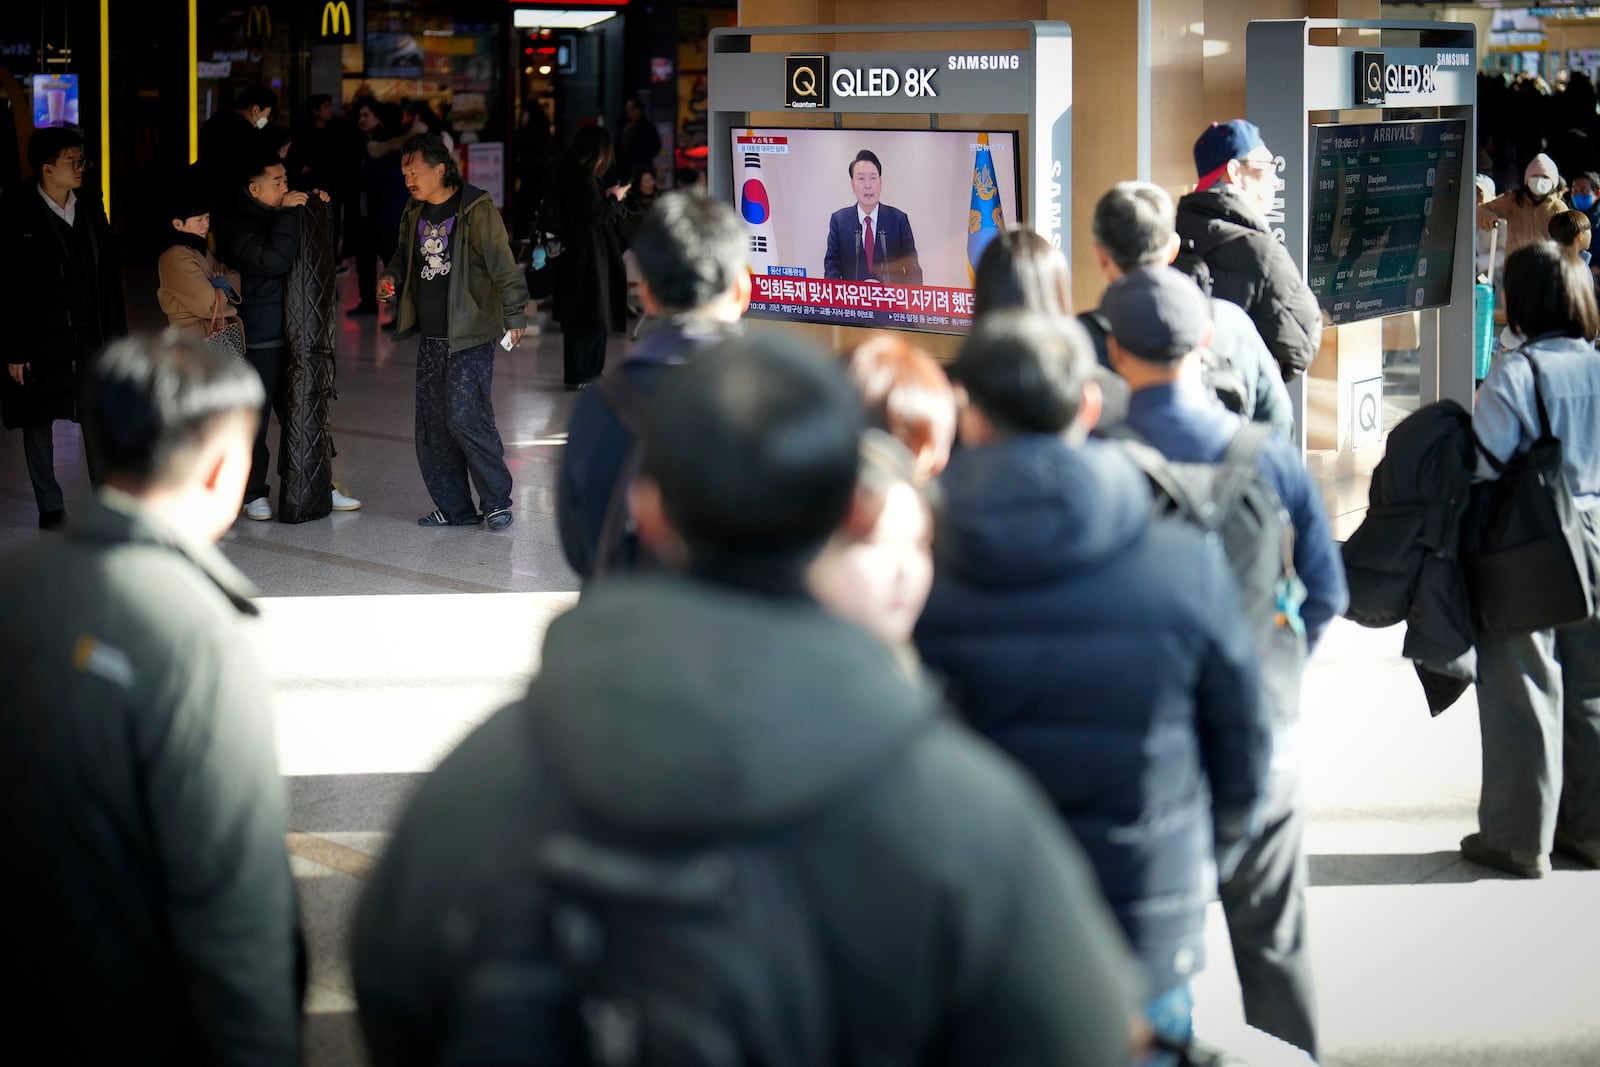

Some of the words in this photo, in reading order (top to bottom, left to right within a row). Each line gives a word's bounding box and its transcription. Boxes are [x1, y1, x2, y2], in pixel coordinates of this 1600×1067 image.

[948, 55, 1020, 70] SAMSUNG
[1436, 53, 1470, 66] SAMSUNG
[792, 66, 818, 97] Q
[832, 68, 900, 97] QLED
[904, 68, 938, 97] 8K
[1367, 62, 1382, 93] Q
[1385, 63, 1421, 92] QLED
[1422, 63, 1439, 93] 8K
[1373, 127, 1415, 143] ARRIVALS
[770, 266, 781, 276] 용산
[782, 267, 804, 277] 대통령실
[750, 302, 766, 310] 10:06
[755, 277, 807, 302] "의회독재
[809, 282, 833, 304] 맞서
[835, 284, 909, 310] 자유민주주의
[911, 289, 950, 313] 지키려
[919, 314, 926, 324] 등
[1359, 392, 1377, 432] Q
